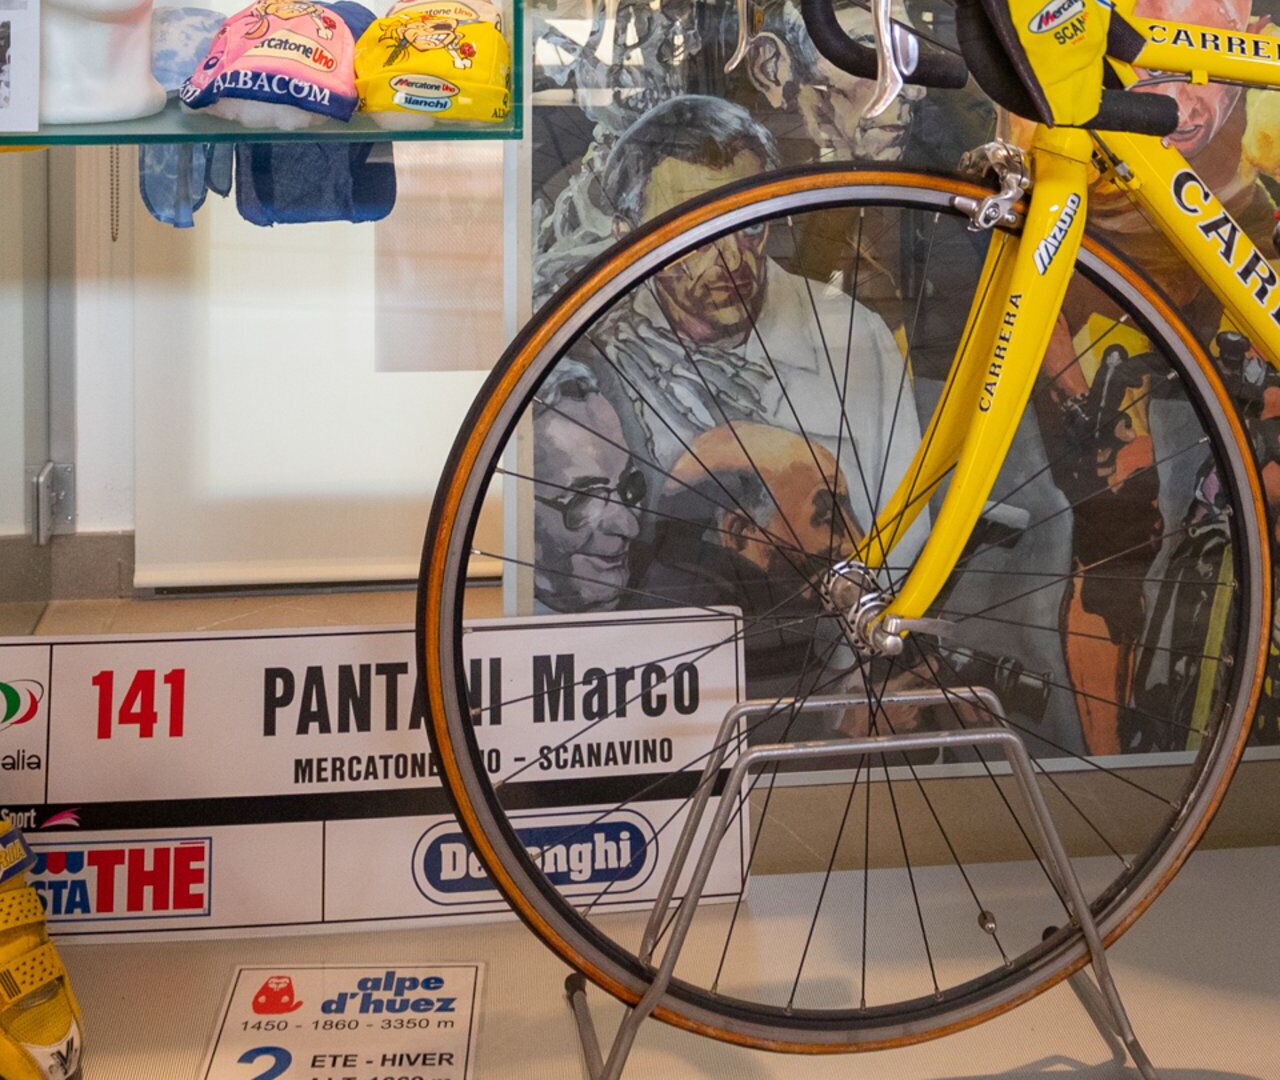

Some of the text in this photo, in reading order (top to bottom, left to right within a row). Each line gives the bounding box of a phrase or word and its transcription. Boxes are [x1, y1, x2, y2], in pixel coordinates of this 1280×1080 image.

[312, 48, 334, 70] Uno
[212, 69, 331, 106] ALBACOM
[394, 78, 440, 91] Mercatone
[978, 292, 1024, 414] CARRERA
[531, 654, 700, 723] Marco
[91, 668, 185, 739] 141
[538, 737, 673, 770] SCANAVINO
[357, 970, 445, 998] alpe
[321, 991, 458, 1015] d'huez
[240, 1018, 455, 1032] 1450 1860 3350 m
[310, 1052, 455, 1069] ETE HIVER
